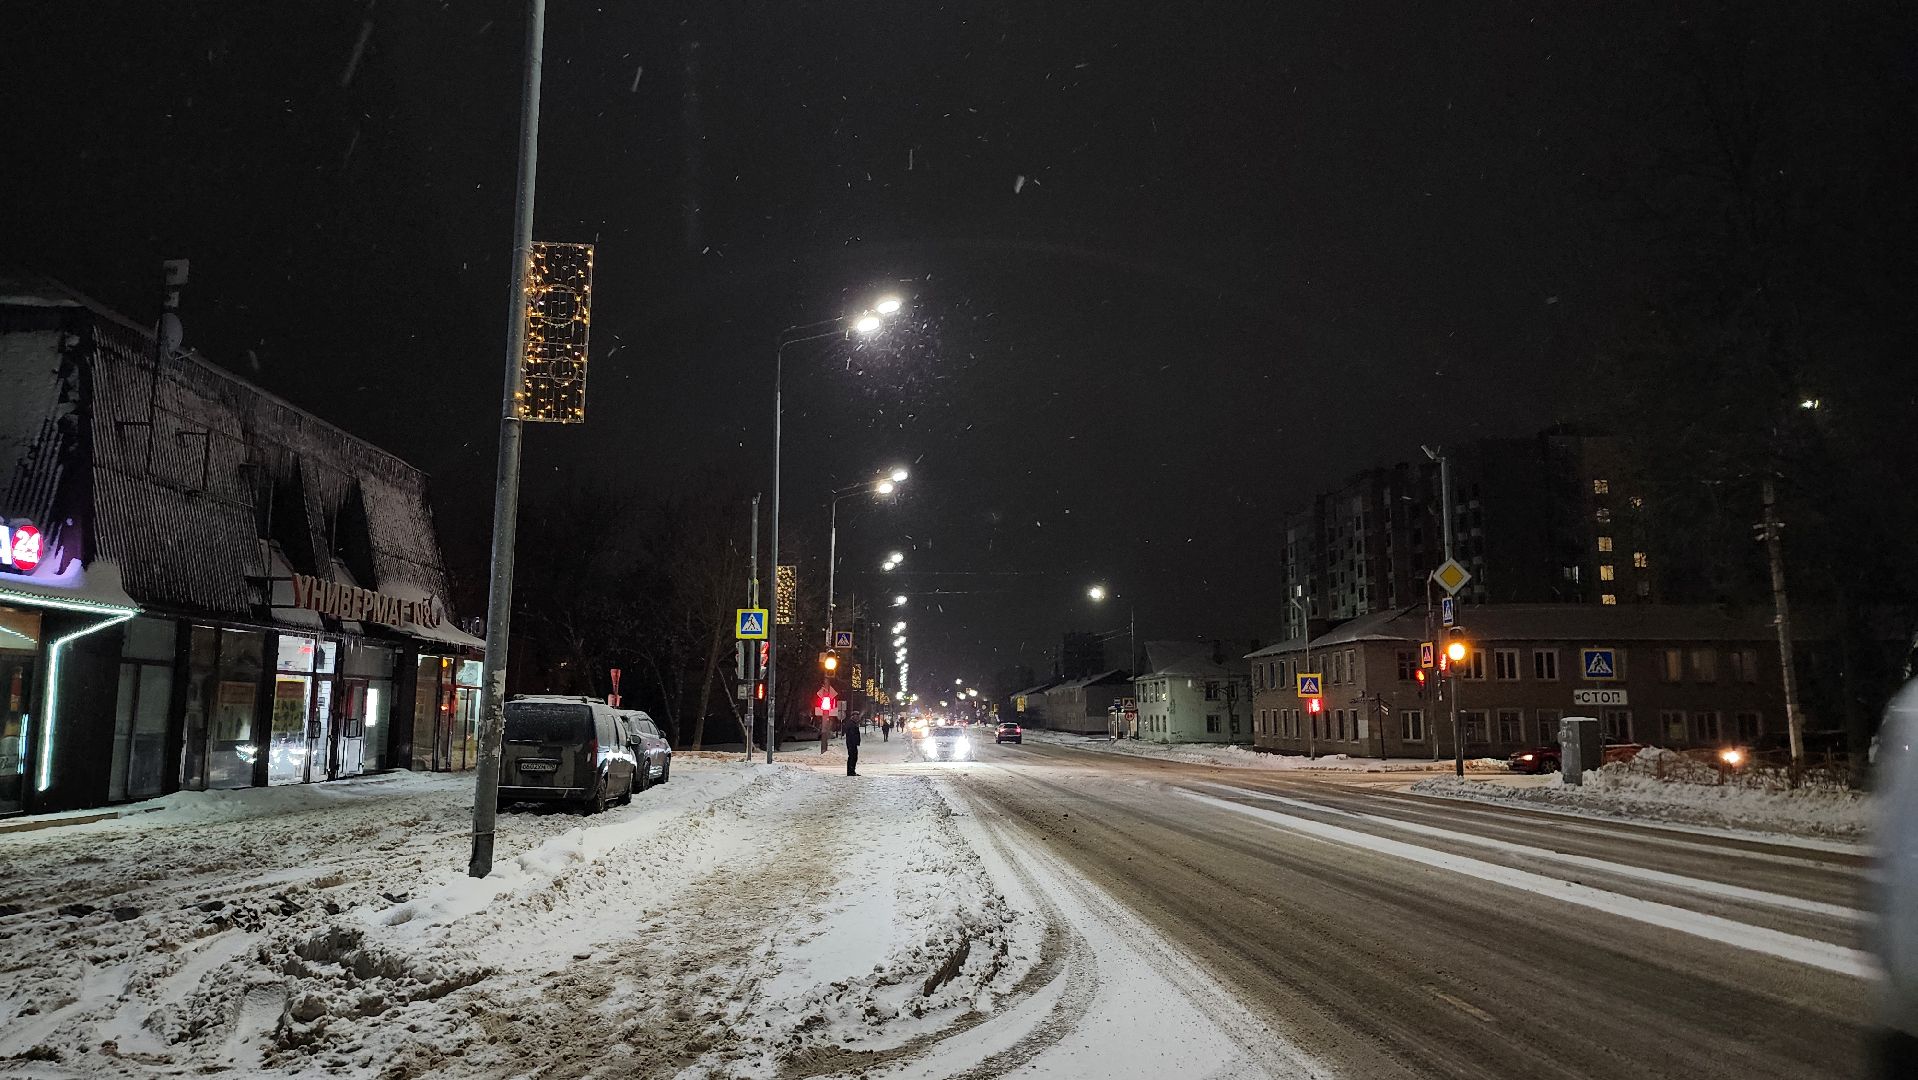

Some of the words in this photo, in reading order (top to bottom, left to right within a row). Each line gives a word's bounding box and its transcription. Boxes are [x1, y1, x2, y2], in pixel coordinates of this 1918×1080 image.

[15, 529, 41, 551] 24
[293, 573, 411, 627] УНИВЕРМАГ
[1582, 691, 1620, 703] СТОП
